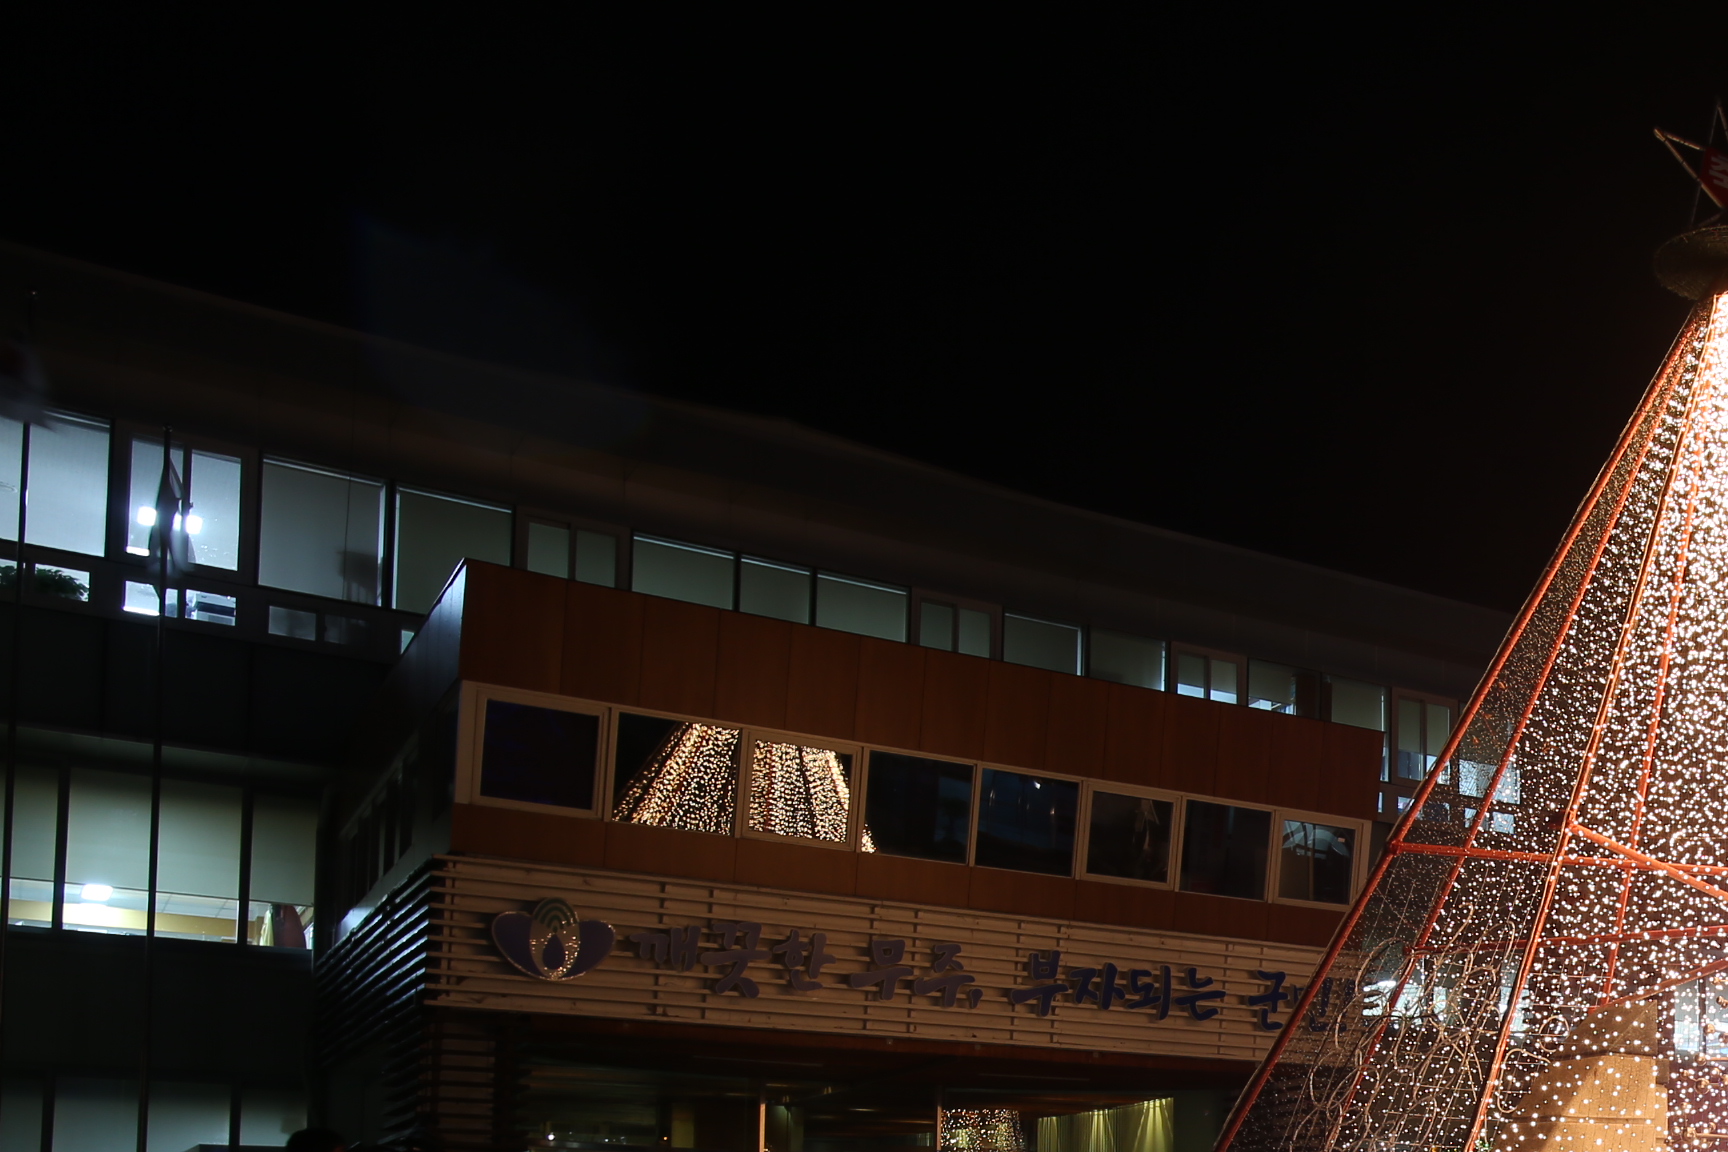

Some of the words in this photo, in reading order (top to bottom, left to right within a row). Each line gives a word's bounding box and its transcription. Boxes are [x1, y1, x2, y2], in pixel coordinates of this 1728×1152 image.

[629, 921, 838, 1000] 깨끗한
[850, 938, 985, 1009] 무주,
[1008, 949, 1228, 1022] 부자되는
